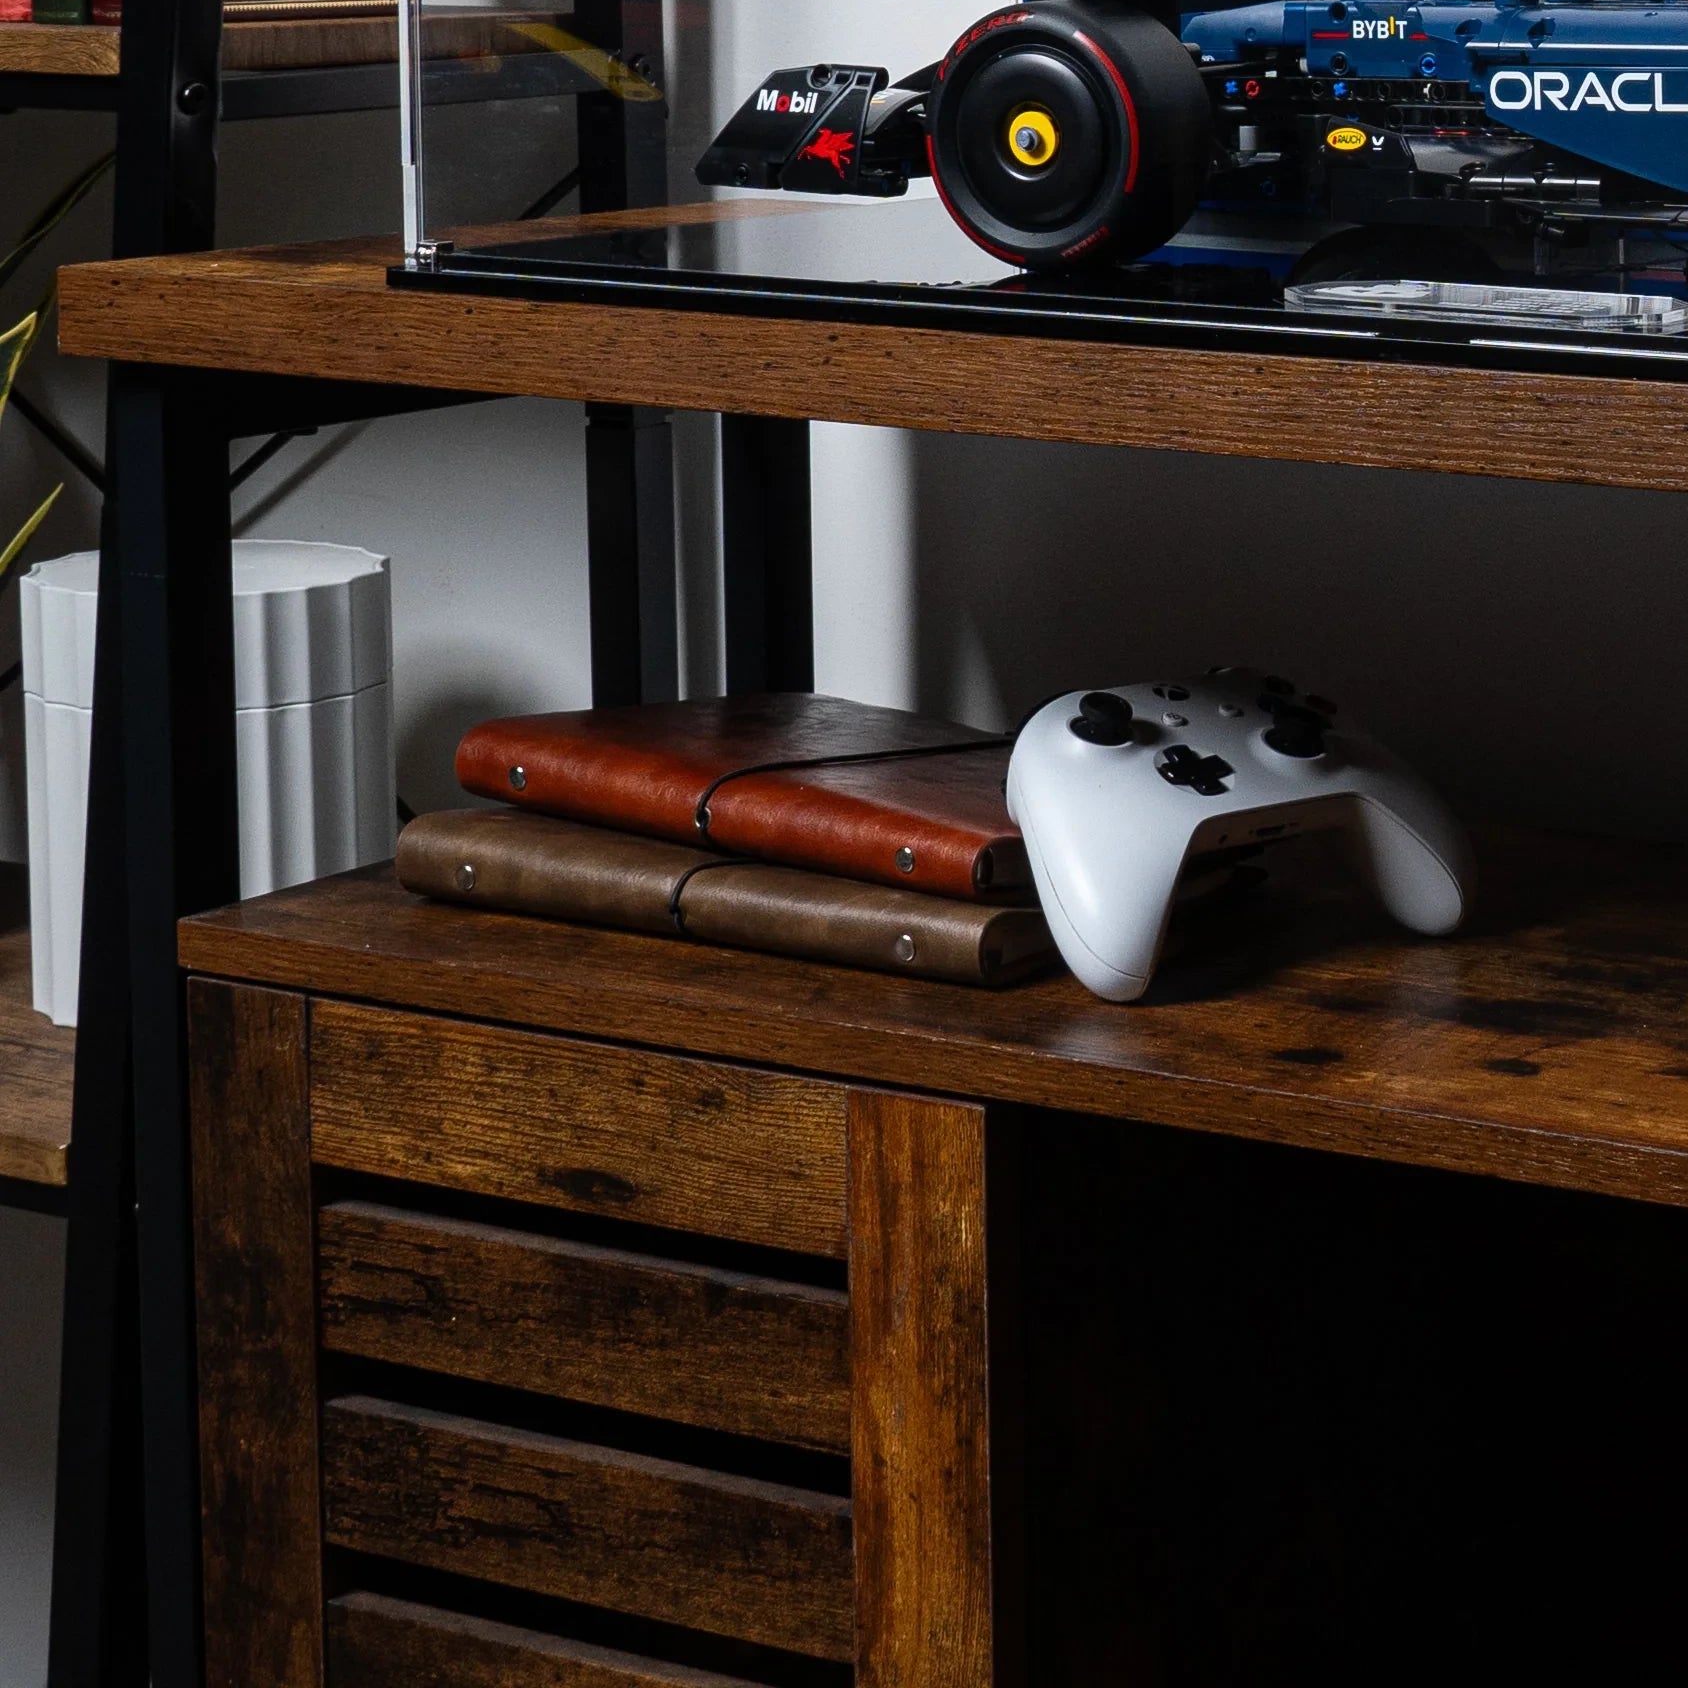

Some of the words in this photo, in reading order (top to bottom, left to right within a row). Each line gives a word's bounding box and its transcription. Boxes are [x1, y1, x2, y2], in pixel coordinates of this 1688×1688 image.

[1353, 16, 1407, 39] BYBIT
[757, 89, 819, 113] Mobil
[1338, 135, 1361, 144] RAUCH
